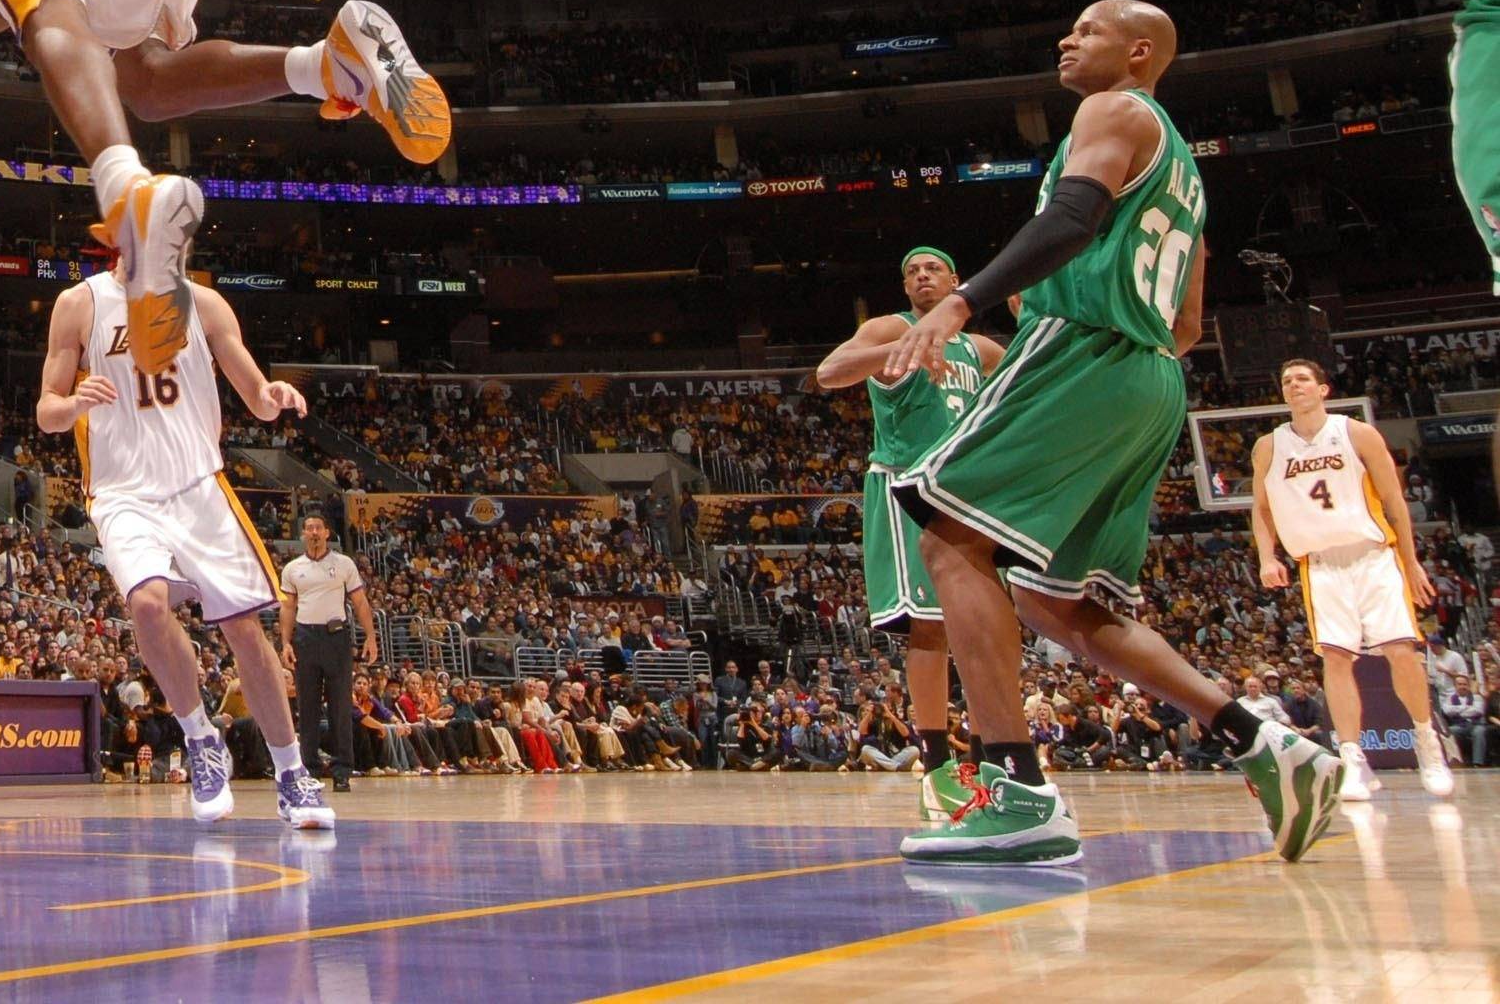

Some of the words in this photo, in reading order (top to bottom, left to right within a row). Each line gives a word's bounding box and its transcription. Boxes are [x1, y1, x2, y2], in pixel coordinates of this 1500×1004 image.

[856, 43, 888, 51] BUD
[895, 37, 939, 47] LIGHT
[892, 169, 907, 178] LA
[920, 167, 942, 177] BOS
[983, 162, 1032, 175] PEPSI
[769, 179, 824, 192] TOYOTA
[893, 178, 908, 188] 42
[925, 176, 940, 186] 44
[601, 189, 660, 198] WACHOVIA
[37, 259, 51, 269] SA
[68, 261, 80, 270] 91
[1133, 206, 1193, 331] 20
[37, 269, 57, 279] PHX
[68, 271, 82, 280] 90
[217, 276, 245, 285] BUD
[250, 277, 287, 286] LIGHT
[315, 278, 343, 289] SPORT
[347, 279, 379, 289] CHALET
[444, 282, 466, 292] WEST
[133, 362, 180, 408] 16
[1284, 454, 1345, 480] LAKERS
[1309, 479, 1335, 510] 4
